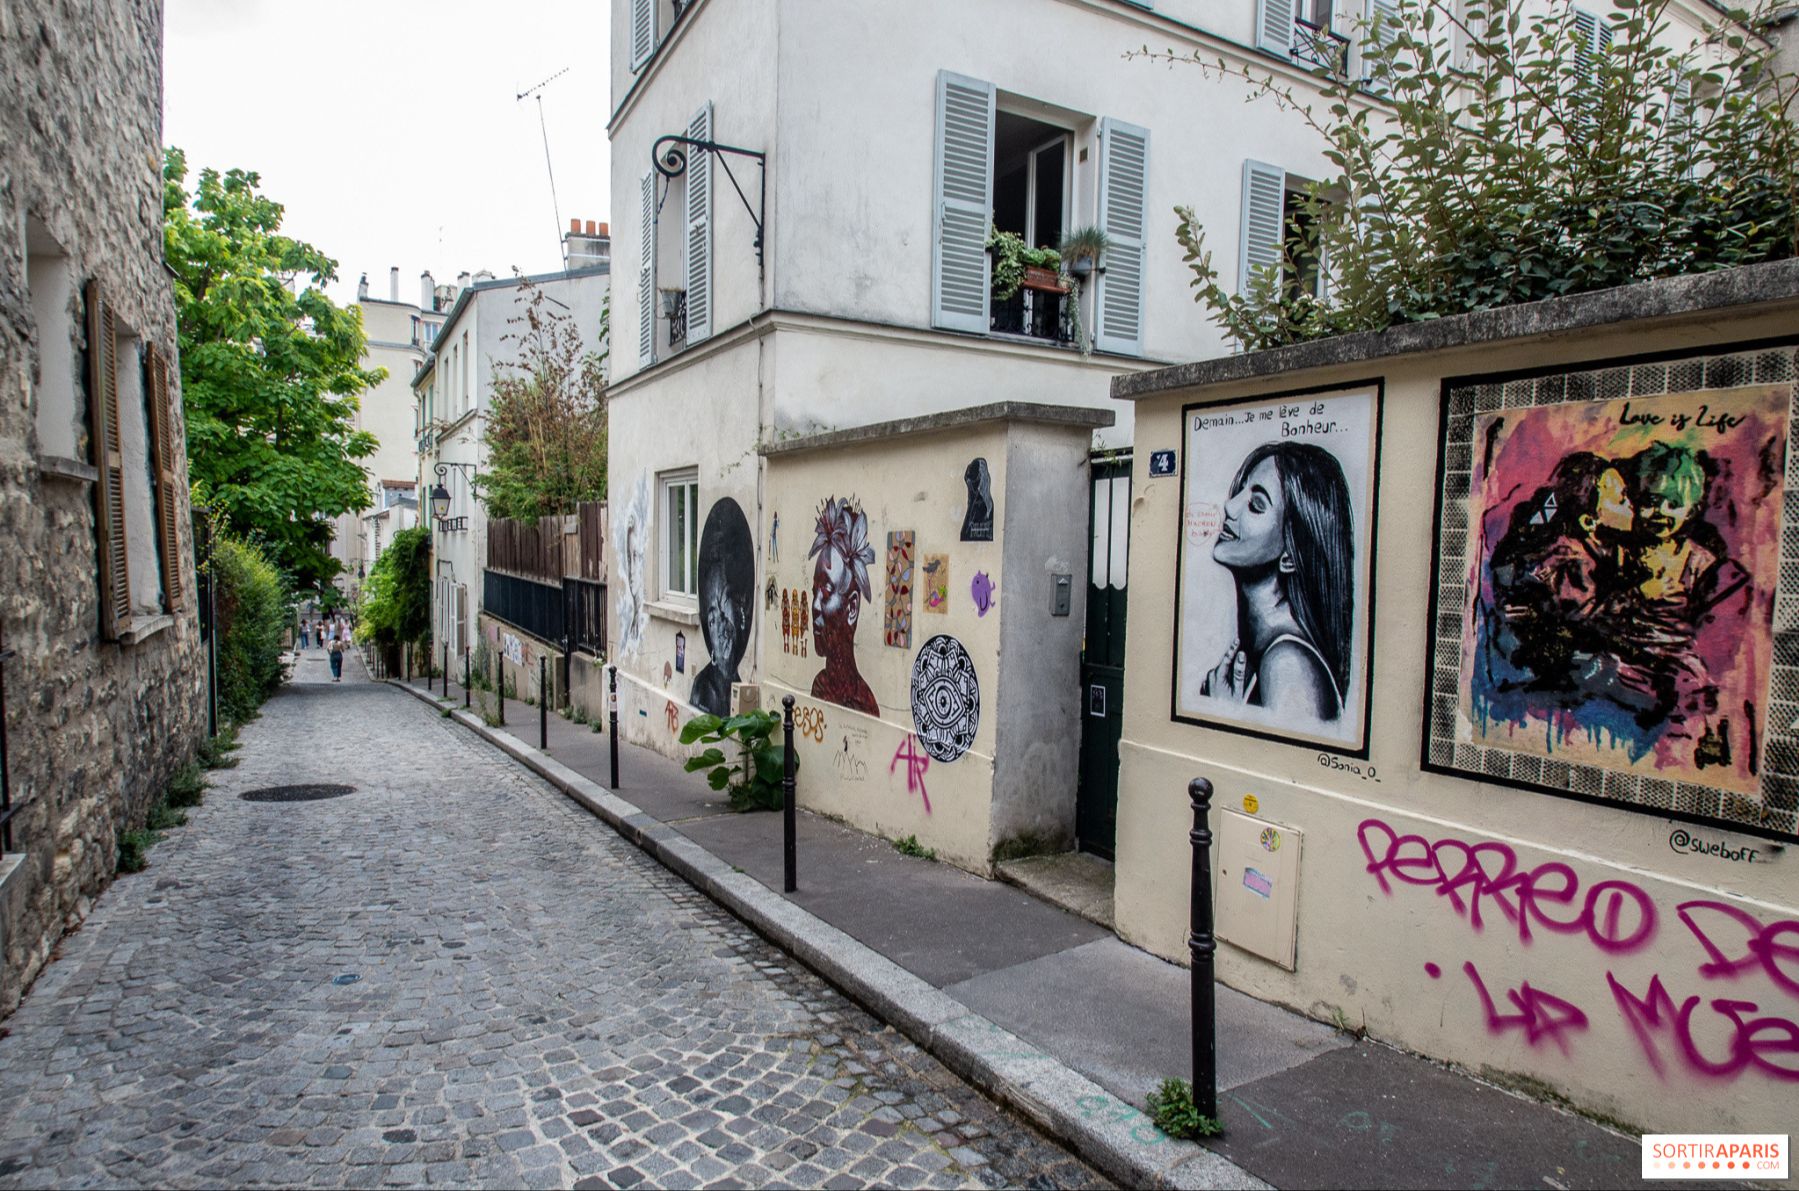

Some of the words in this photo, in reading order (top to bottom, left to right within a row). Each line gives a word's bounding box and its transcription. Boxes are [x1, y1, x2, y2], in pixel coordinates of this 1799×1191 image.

[1259, 410, 1273, 421] me
[1309, 401, 1325, 416] de
[1619, 402, 1665, 425] Love
[1671, 413, 1692, 431] is
[1696, 405, 1747, 434] Life
[1158, 453, 1169, 472] 4
